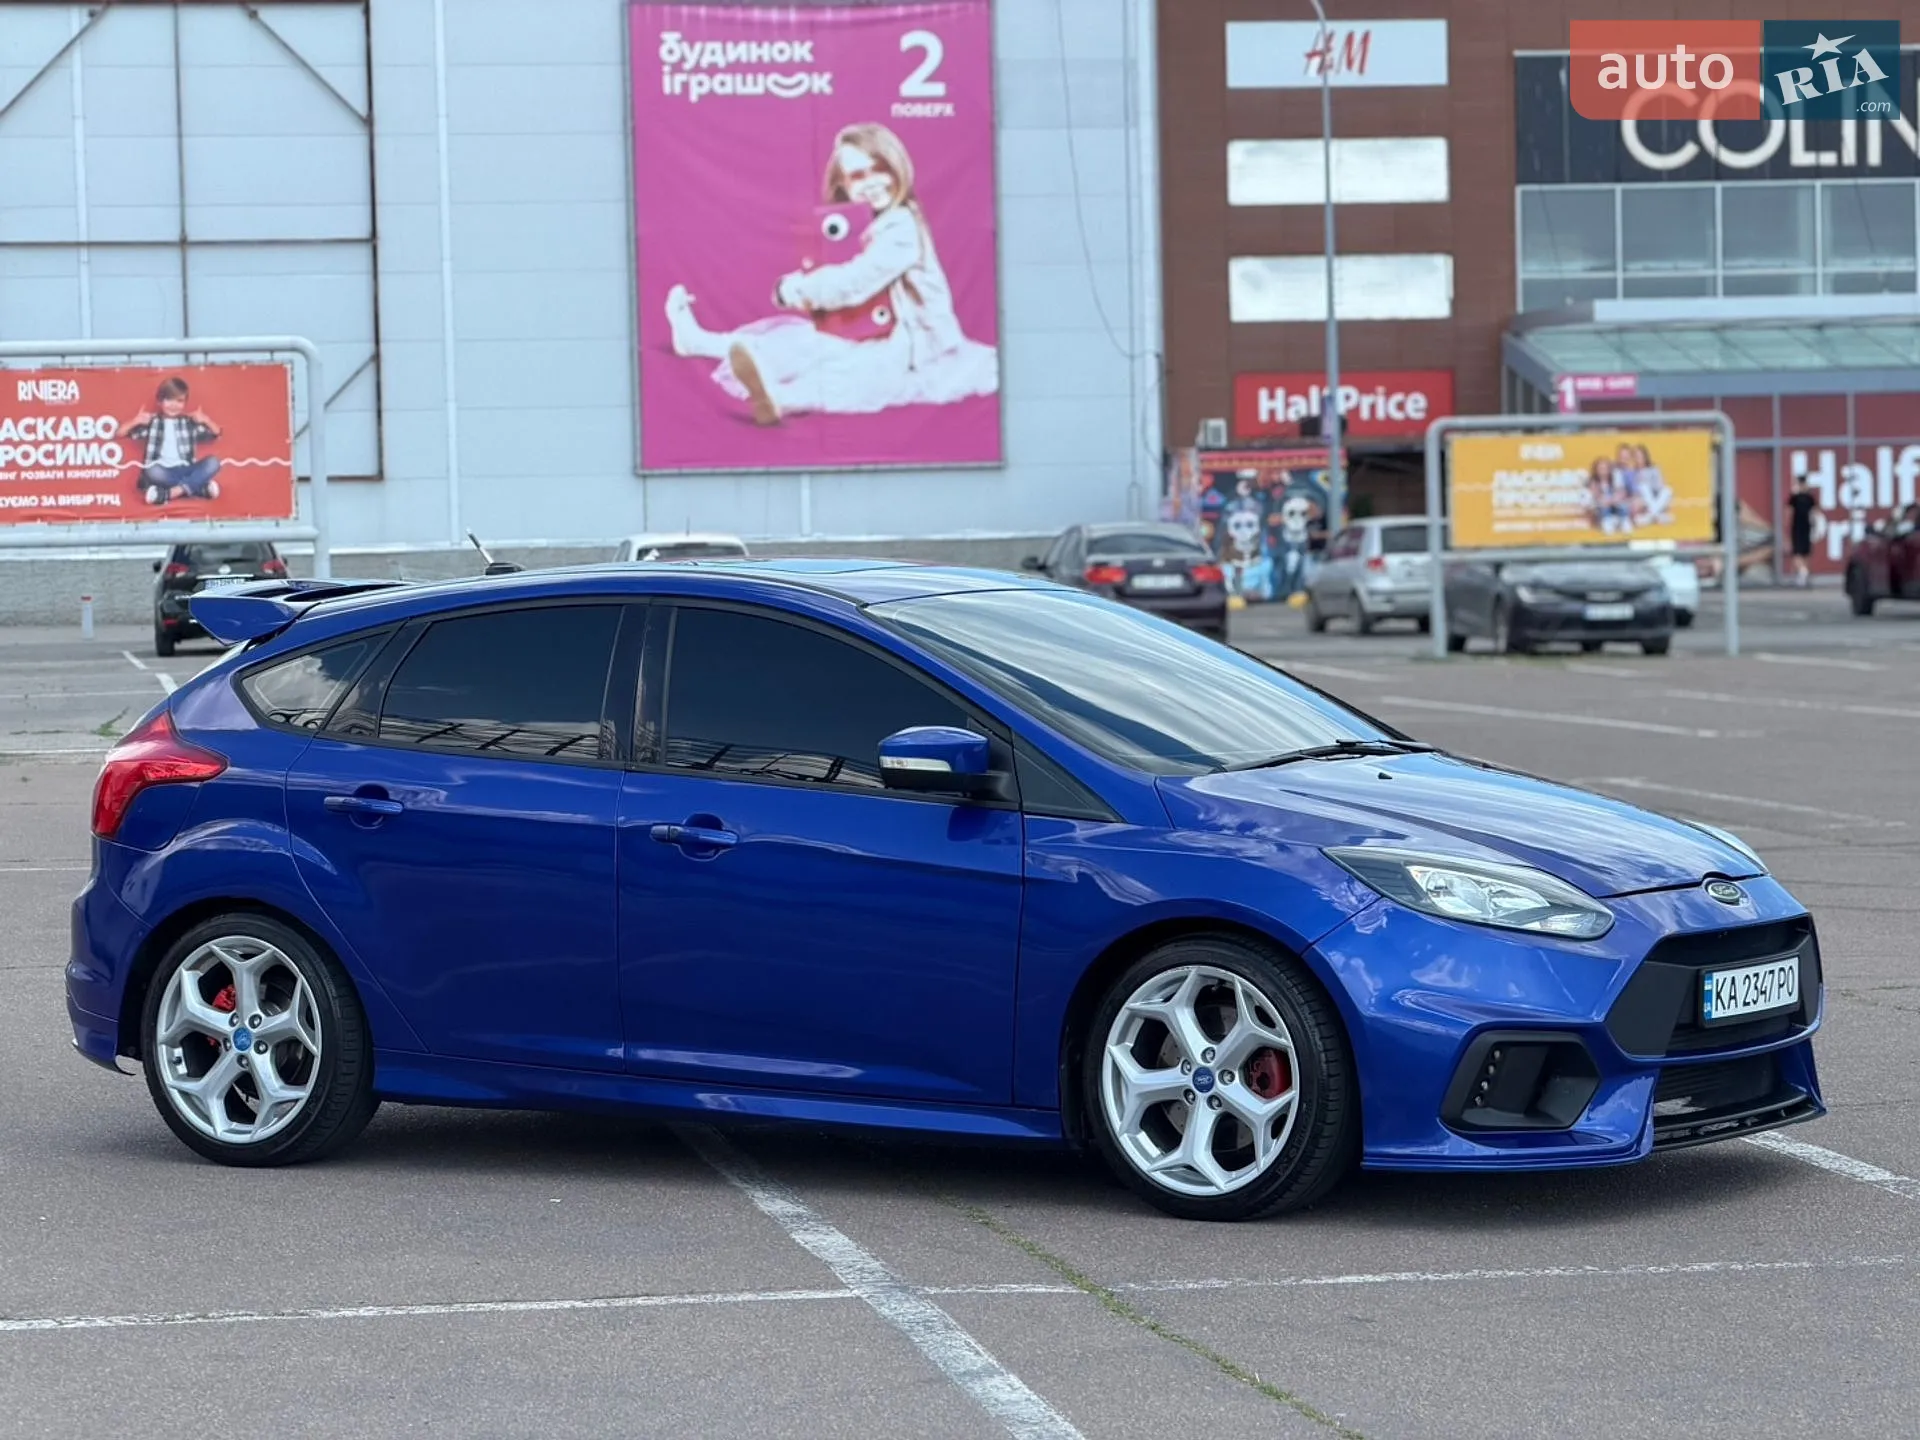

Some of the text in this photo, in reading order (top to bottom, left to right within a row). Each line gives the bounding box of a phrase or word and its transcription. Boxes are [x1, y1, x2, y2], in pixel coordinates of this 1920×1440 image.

[660, 32, 814, 70] будинок
[899, 30, 946, 98] 2
[662, 66, 833, 103] іграшок
[17, 379, 80, 402] RIVIERA
[0, 414, 119, 441] АСКАВО
[0, 442, 122, 467] РОСИМО
[1791, 444, 1920, 510] Half
[41, 495, 56, 507] ЗА
[1715, 976, 1738, 1012] KA
[1743, 969, 1775, 1007] 2347
